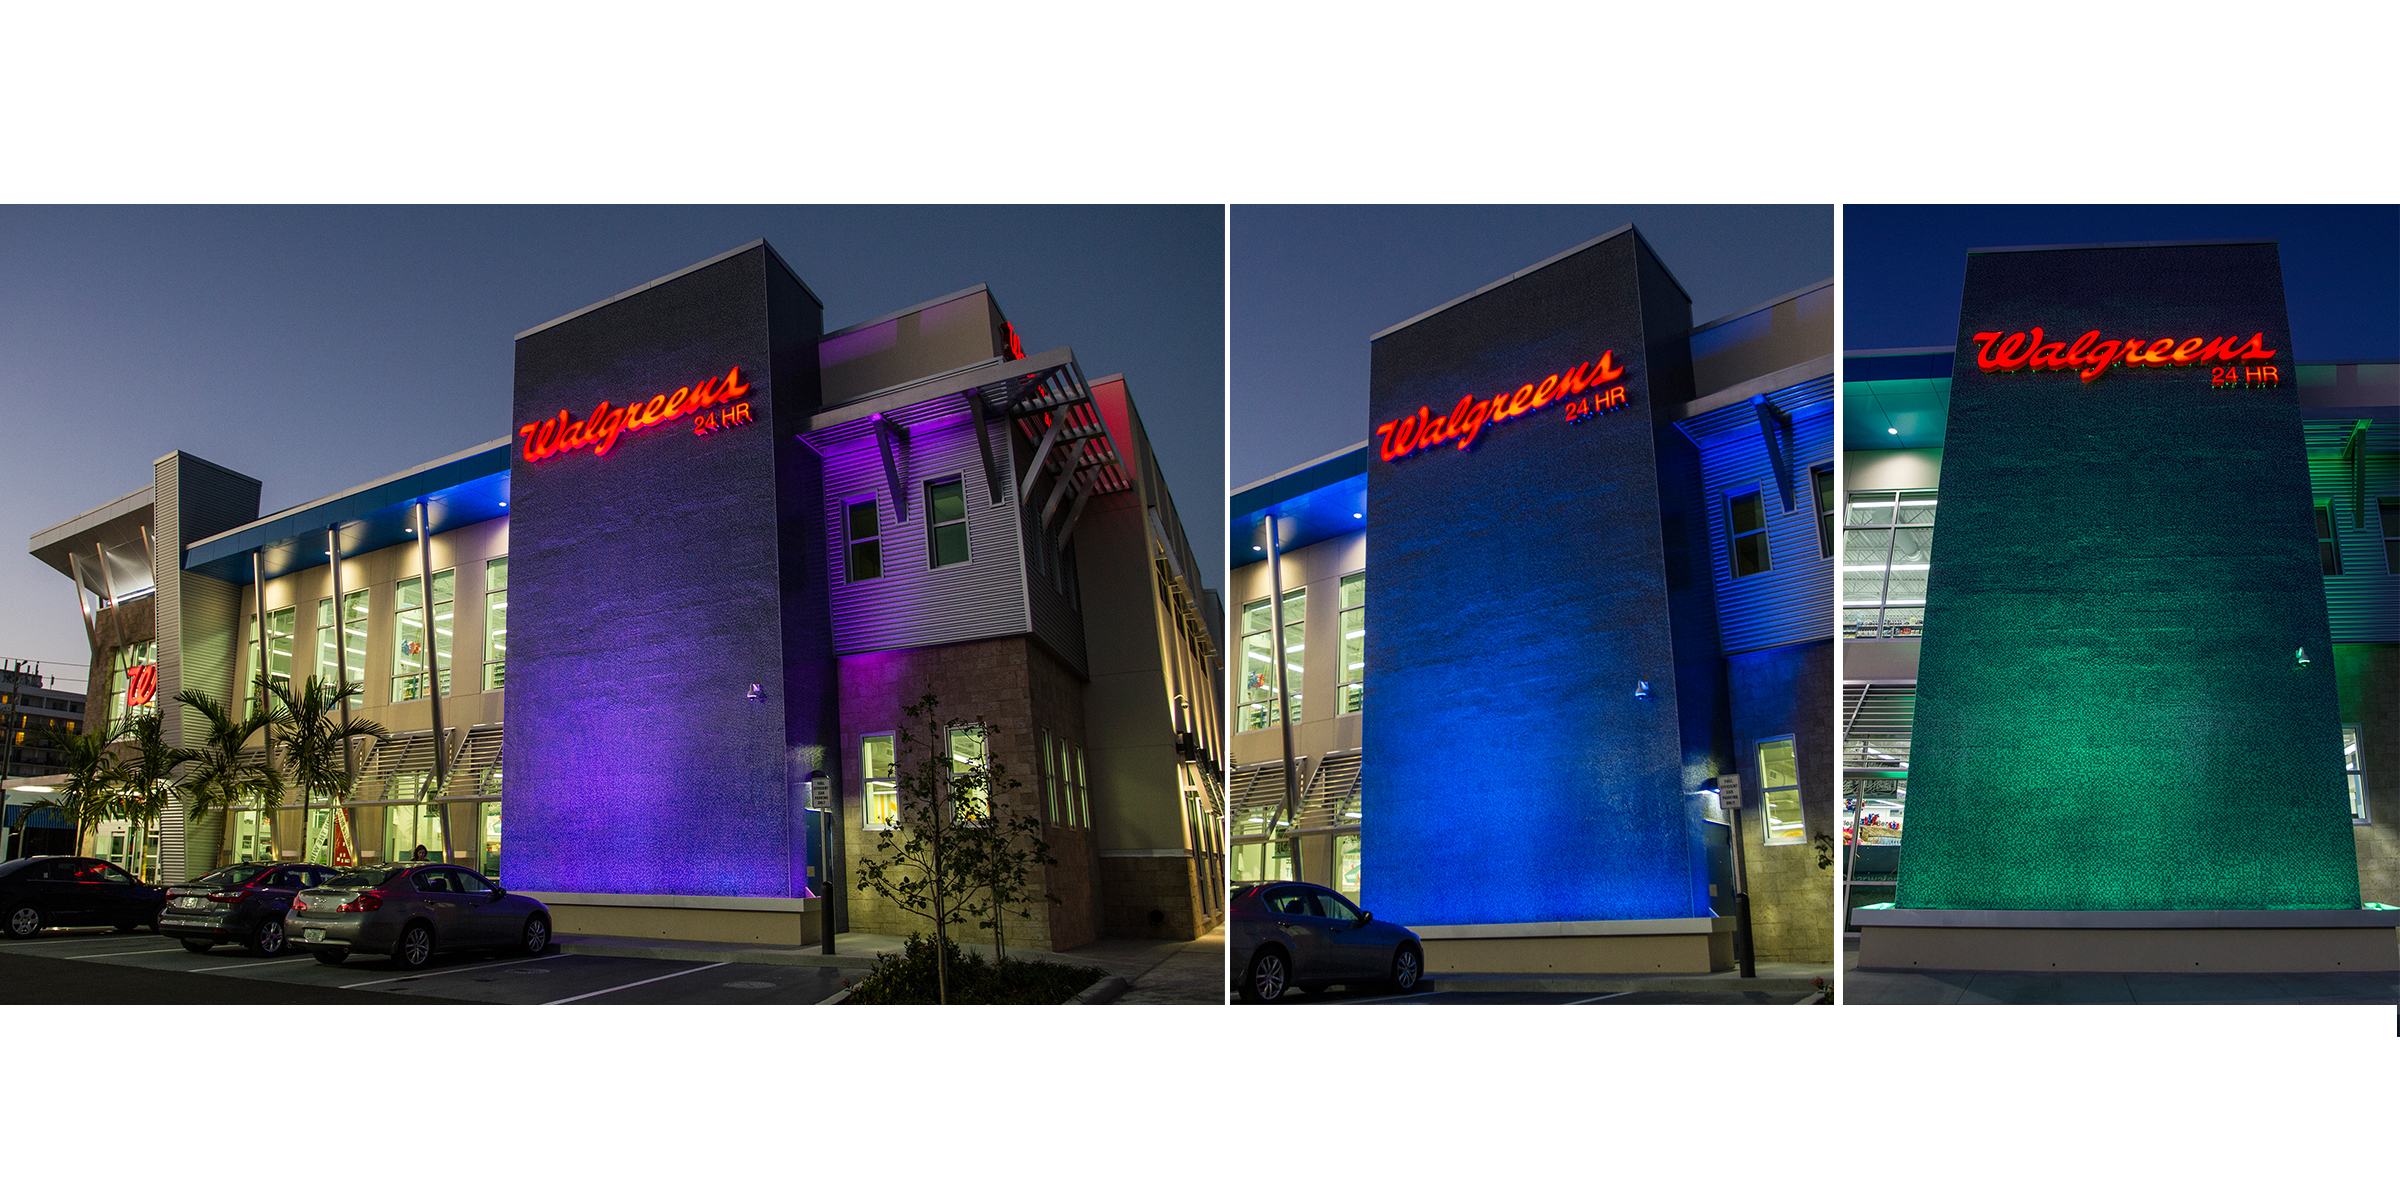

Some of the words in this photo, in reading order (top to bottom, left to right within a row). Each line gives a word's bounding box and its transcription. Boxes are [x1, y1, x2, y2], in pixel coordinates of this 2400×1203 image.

[1973, 327, 2277, 382] Walgreens
[2212, 367, 2239, 384] 24
[2245, 366, 2279, 384] HR
[519, 366, 750, 462] Walgreens
[694, 412, 717, 434] 24
[722, 402, 750, 423] HR
[1376, 350, 1624, 462] Walgreens
[1565, 398, 1590, 421] 24
[1595, 386, 1626, 411] HR
